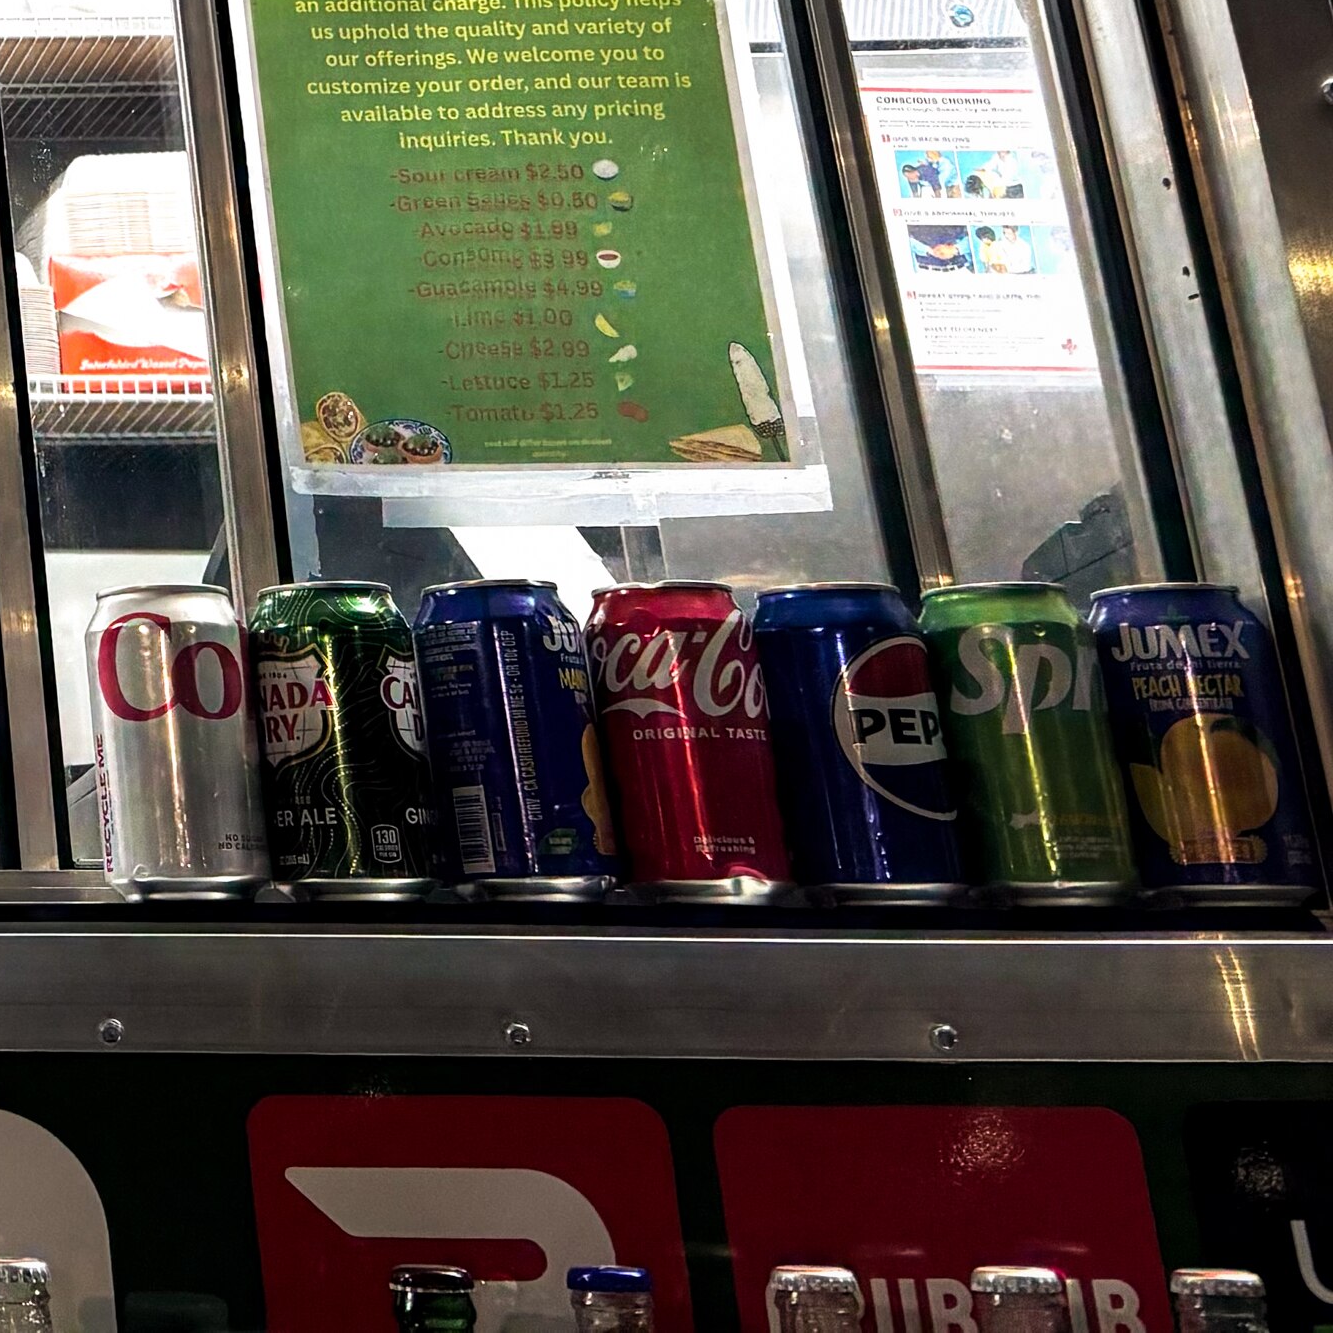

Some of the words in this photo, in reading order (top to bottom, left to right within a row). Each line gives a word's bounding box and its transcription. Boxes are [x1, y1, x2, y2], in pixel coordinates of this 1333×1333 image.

[296, 1, 318, 12] an
[326, 55, 359, 67] our
[366, 50, 462, 69] offerings.
[466, 49, 498, 64] We
[503, 46, 595, 62] welcome
[600, 49, 638, 65] you
[643, 46, 664, 60] to
[399, 131, 495, 152] inquiries.
[500, 128, 565, 146] Thank
[569, 132, 613, 148] you.
[1111, 620, 1250, 662] JUMEX
[98, 602, 247, 722] Co
[1132, 674, 1182, 699] PEACH
[266, 714, 300, 744] RY.
[633, 727, 720, 740] ORIGINAL
[725, 727, 767, 741] TASTE
[854, 709, 939, 745] PEP
[96, 734, 105, 767] ME
[300, 808, 338, 825] ALE
[376, 830, 396, 844] 130
